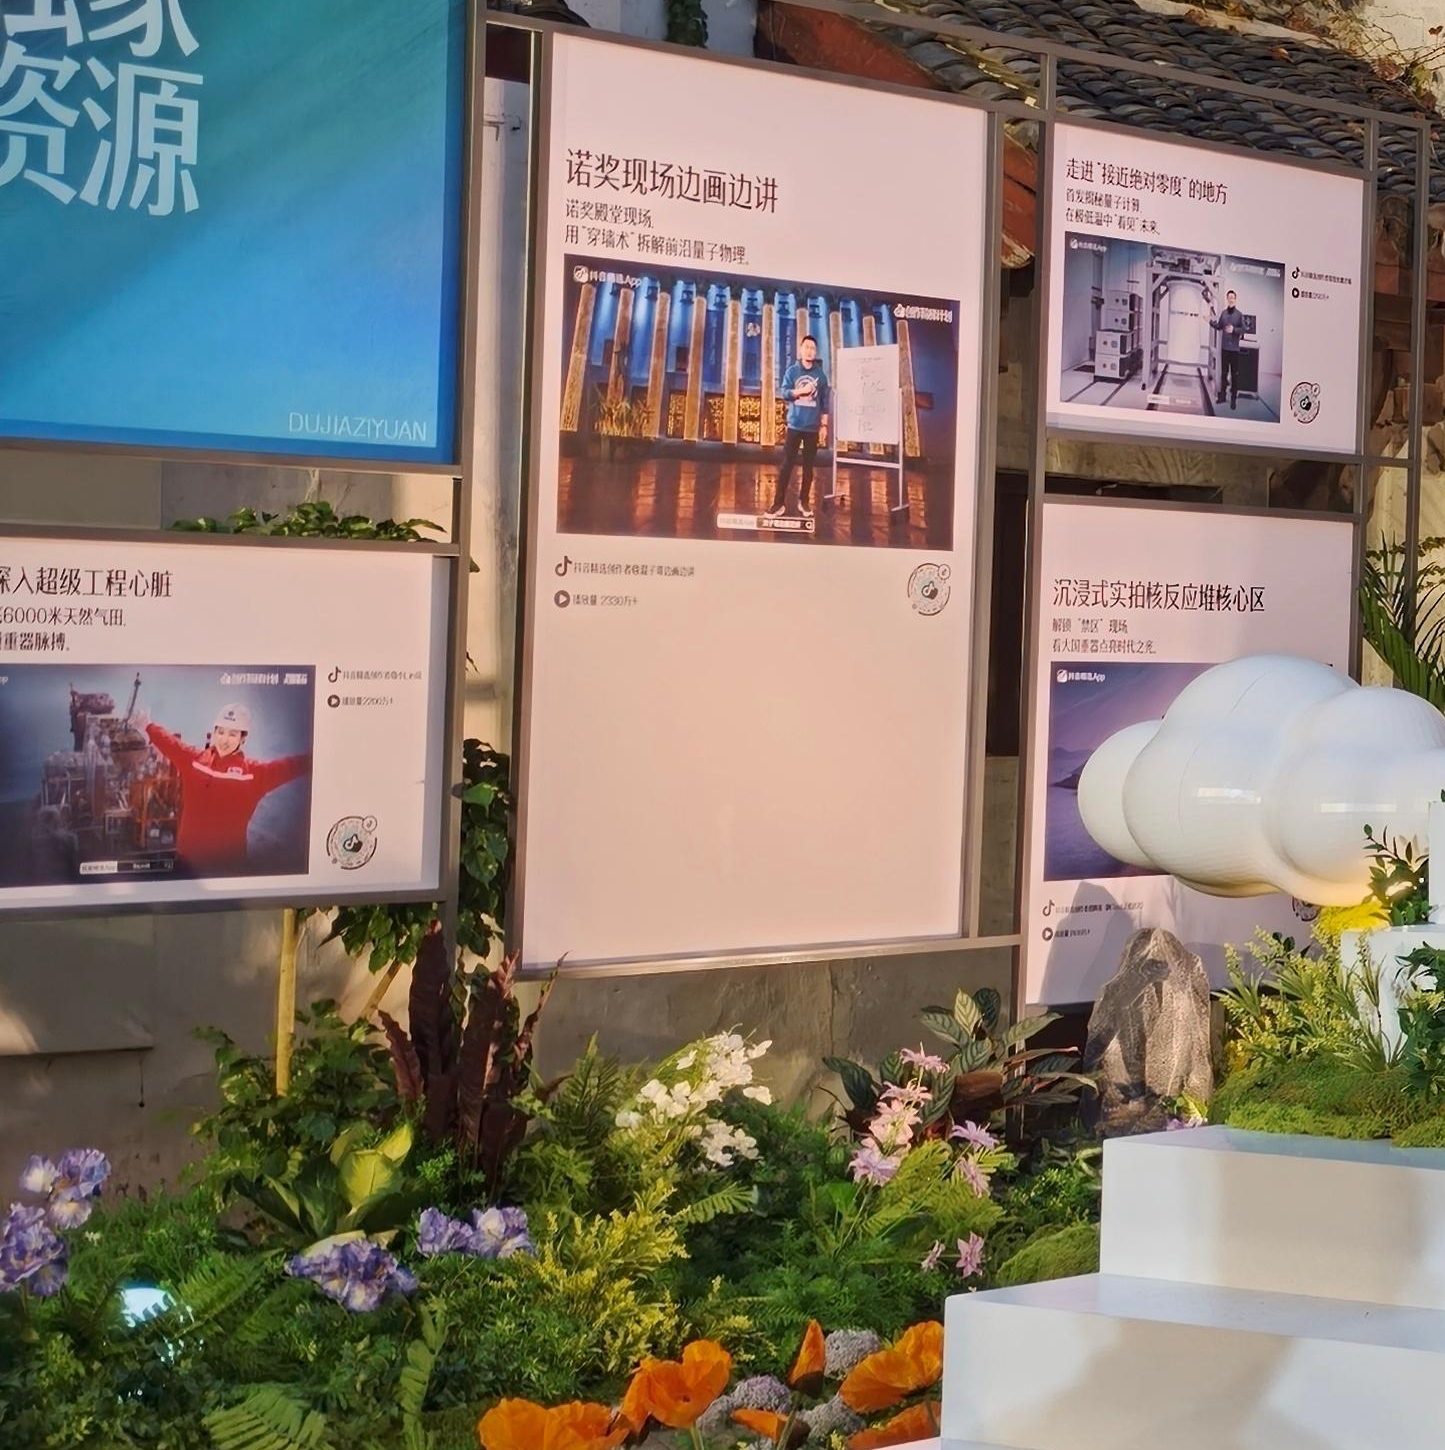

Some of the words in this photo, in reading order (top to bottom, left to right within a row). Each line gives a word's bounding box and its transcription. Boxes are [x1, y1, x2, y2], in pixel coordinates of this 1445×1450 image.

[566, 148, 779, 214] 诺奖现场边画边讲
[289, 411, 427, 442] DUJIAZIYUAN
[1052, 579, 1265, 612] 沉浸式实拍核反应堆核心区
[0, 606, 126, 627] 6000米天然气田，
[0, 631, 70, 651] 重器脉搏。
